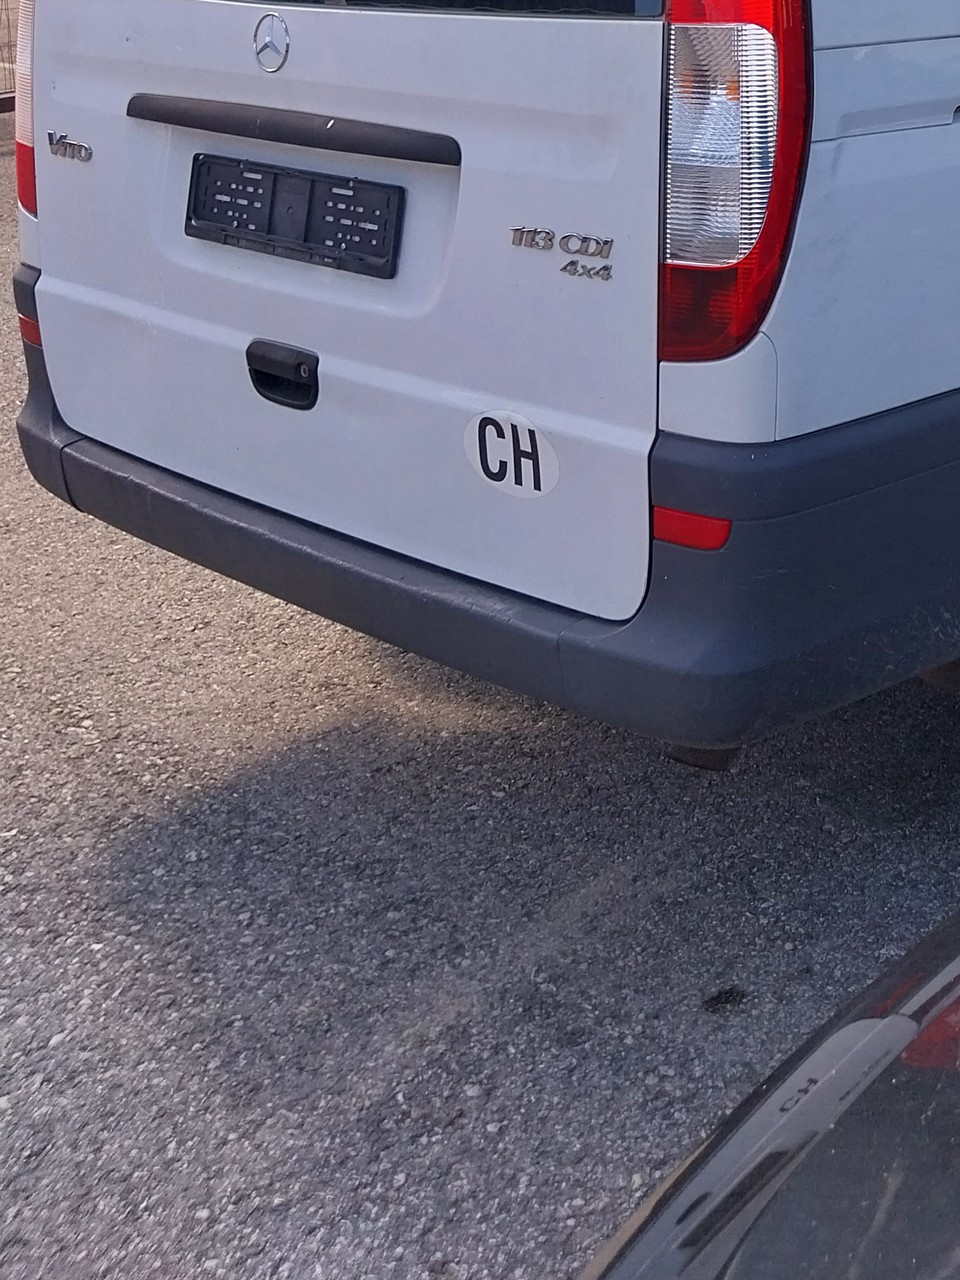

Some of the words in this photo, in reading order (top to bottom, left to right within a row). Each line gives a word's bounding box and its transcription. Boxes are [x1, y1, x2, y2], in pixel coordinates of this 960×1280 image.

[509, 226, 556, 250] 113
[558, 232, 614, 259] CDI
[560, 259, 613, 281] 4x4
[477, 416, 542, 492] CH
